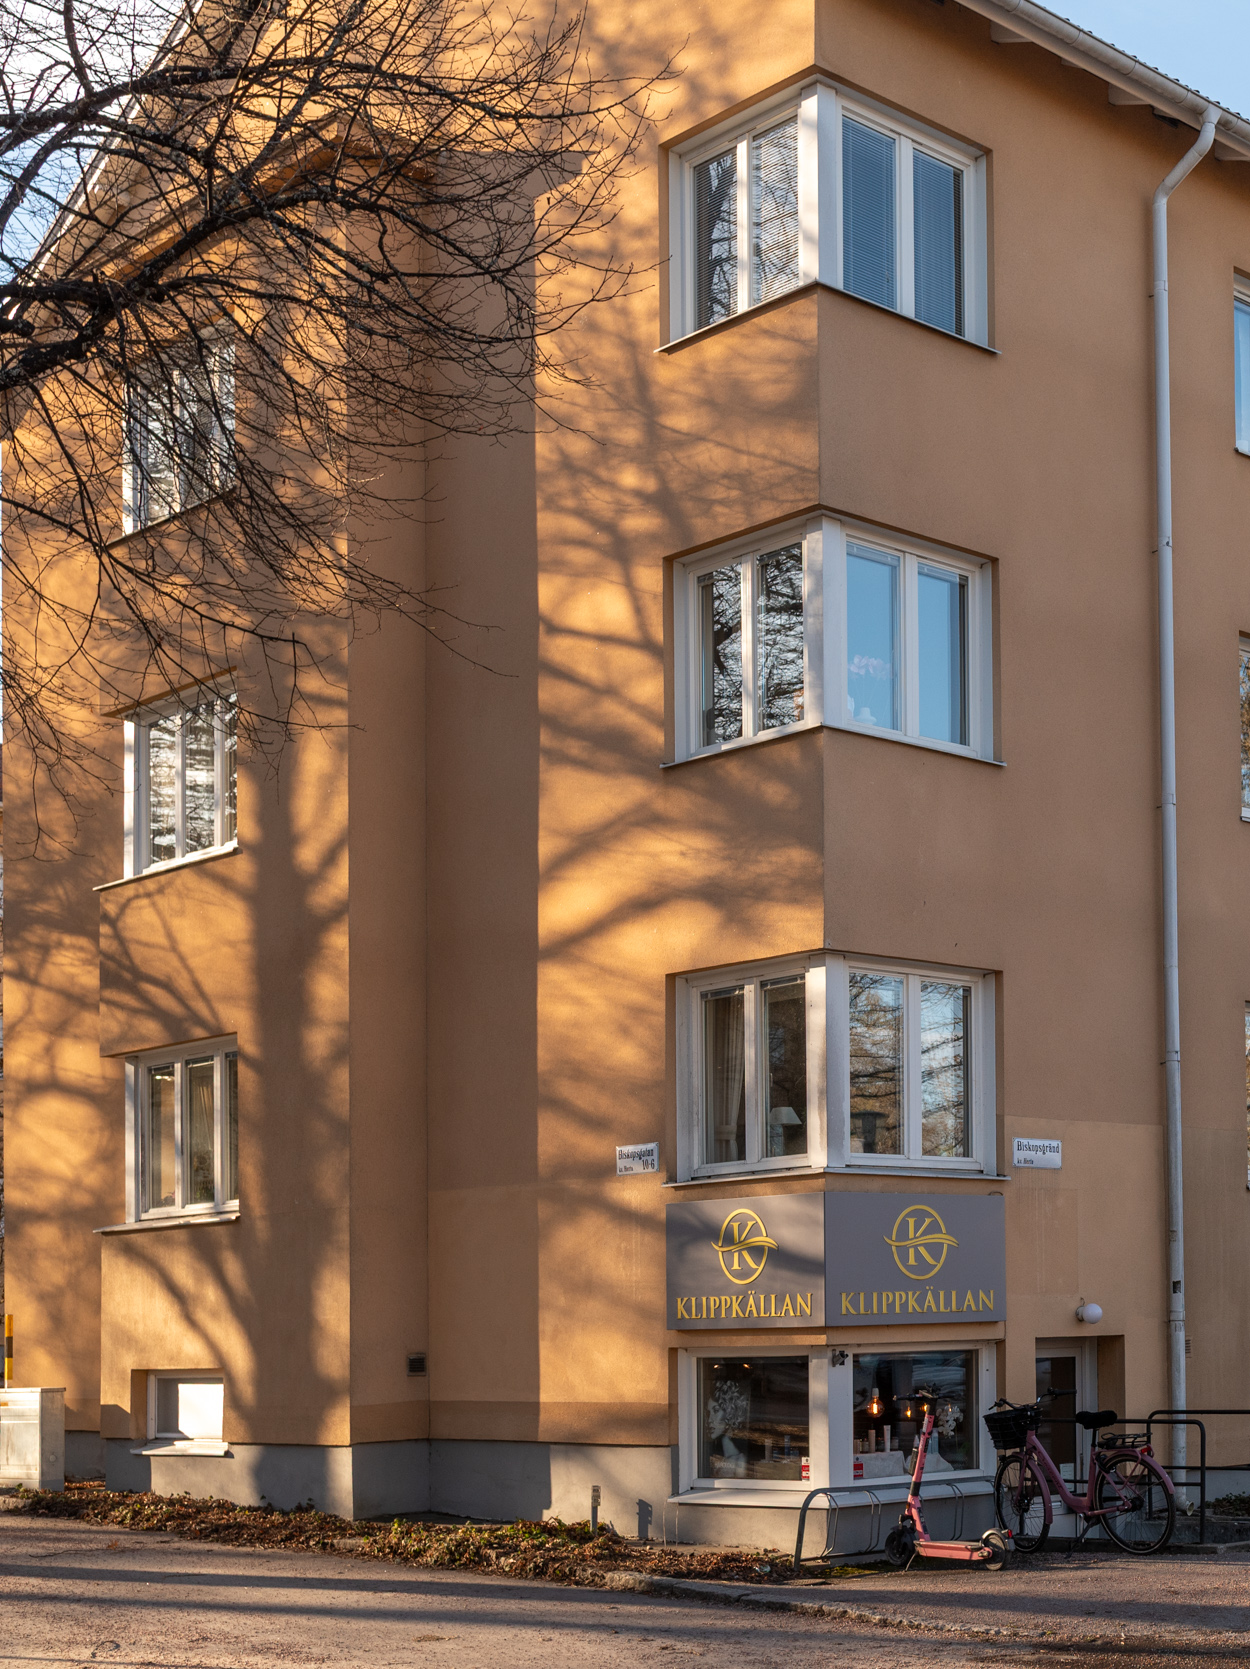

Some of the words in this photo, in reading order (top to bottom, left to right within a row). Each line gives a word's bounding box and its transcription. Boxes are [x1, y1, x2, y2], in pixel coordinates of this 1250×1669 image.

[618, 1148, 654, 1160] Biskopsgatan
[1017, 1140, 1060, 1155] Biskopsgränd
[642, 1159, 655, 1170] 10-6
[676, 1290, 813, 1319] KLIPPKÄLLAN
[840, 1286, 994, 1315] KLIPPKÄLLAN
